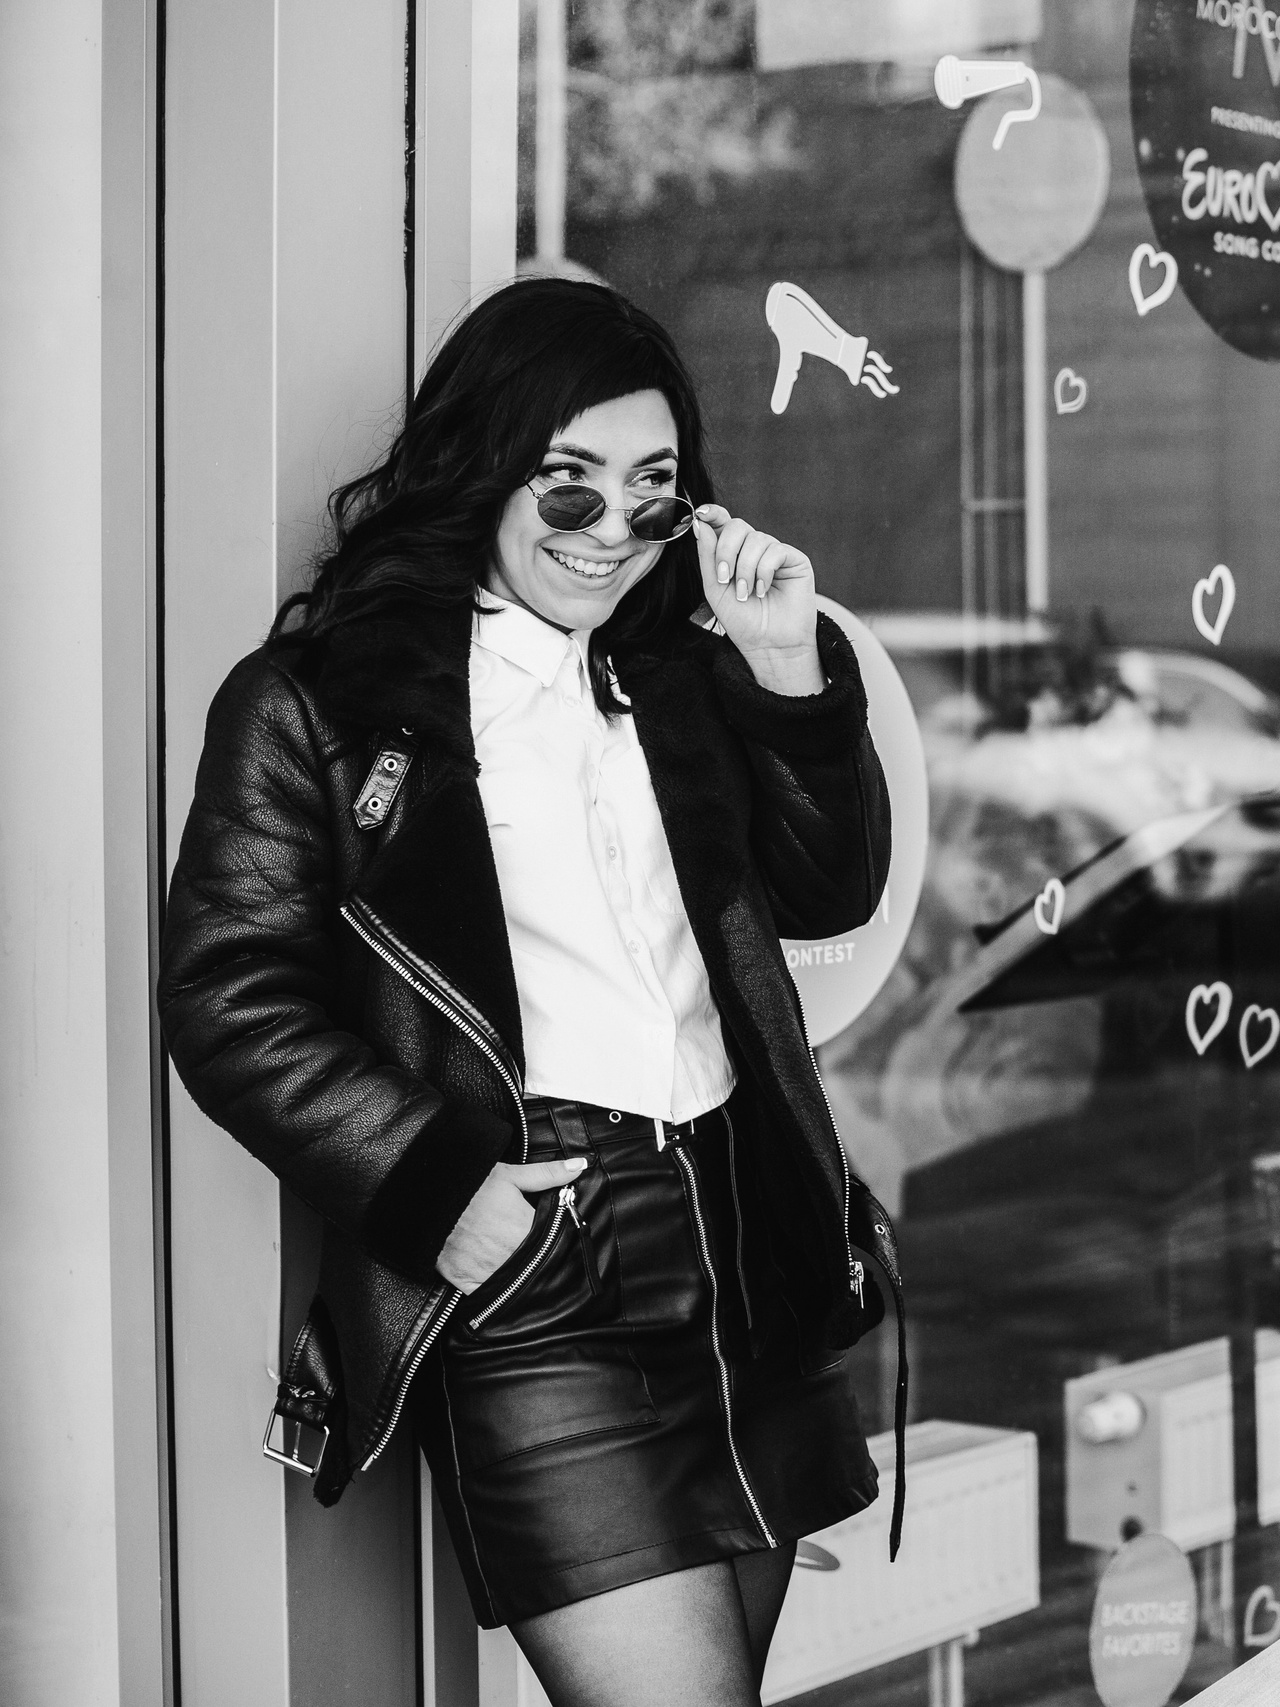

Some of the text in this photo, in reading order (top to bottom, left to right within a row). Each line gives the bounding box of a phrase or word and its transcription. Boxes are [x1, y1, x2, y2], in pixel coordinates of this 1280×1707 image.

[1213, 231, 1259, 259] SONG
[786, 942, 855, 968] ONTEST
[1101, 1601, 1188, 1627] BACKSTAGE
[1102, 1632, 1181, 1658] FAVORITES
